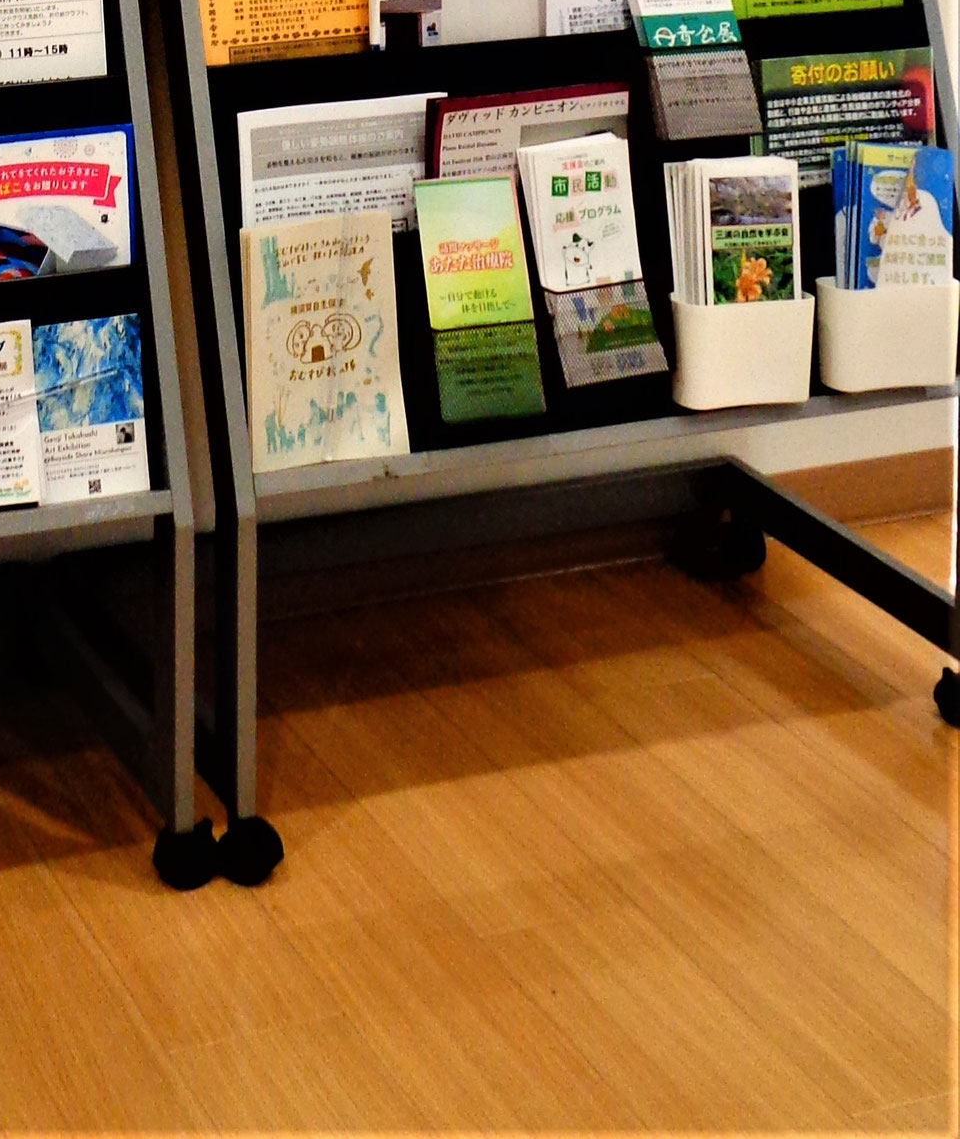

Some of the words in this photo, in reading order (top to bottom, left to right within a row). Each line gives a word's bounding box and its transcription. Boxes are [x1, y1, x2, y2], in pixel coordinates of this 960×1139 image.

[790, 60, 896, 86] 寄付のお願い
[446, 107, 504, 125] ダヴィッド
[510, 101, 579, 118] カンピニオン
[553, 172, 617, 196] 市民活動
[554, 205, 622, 224] 応援プログラム
